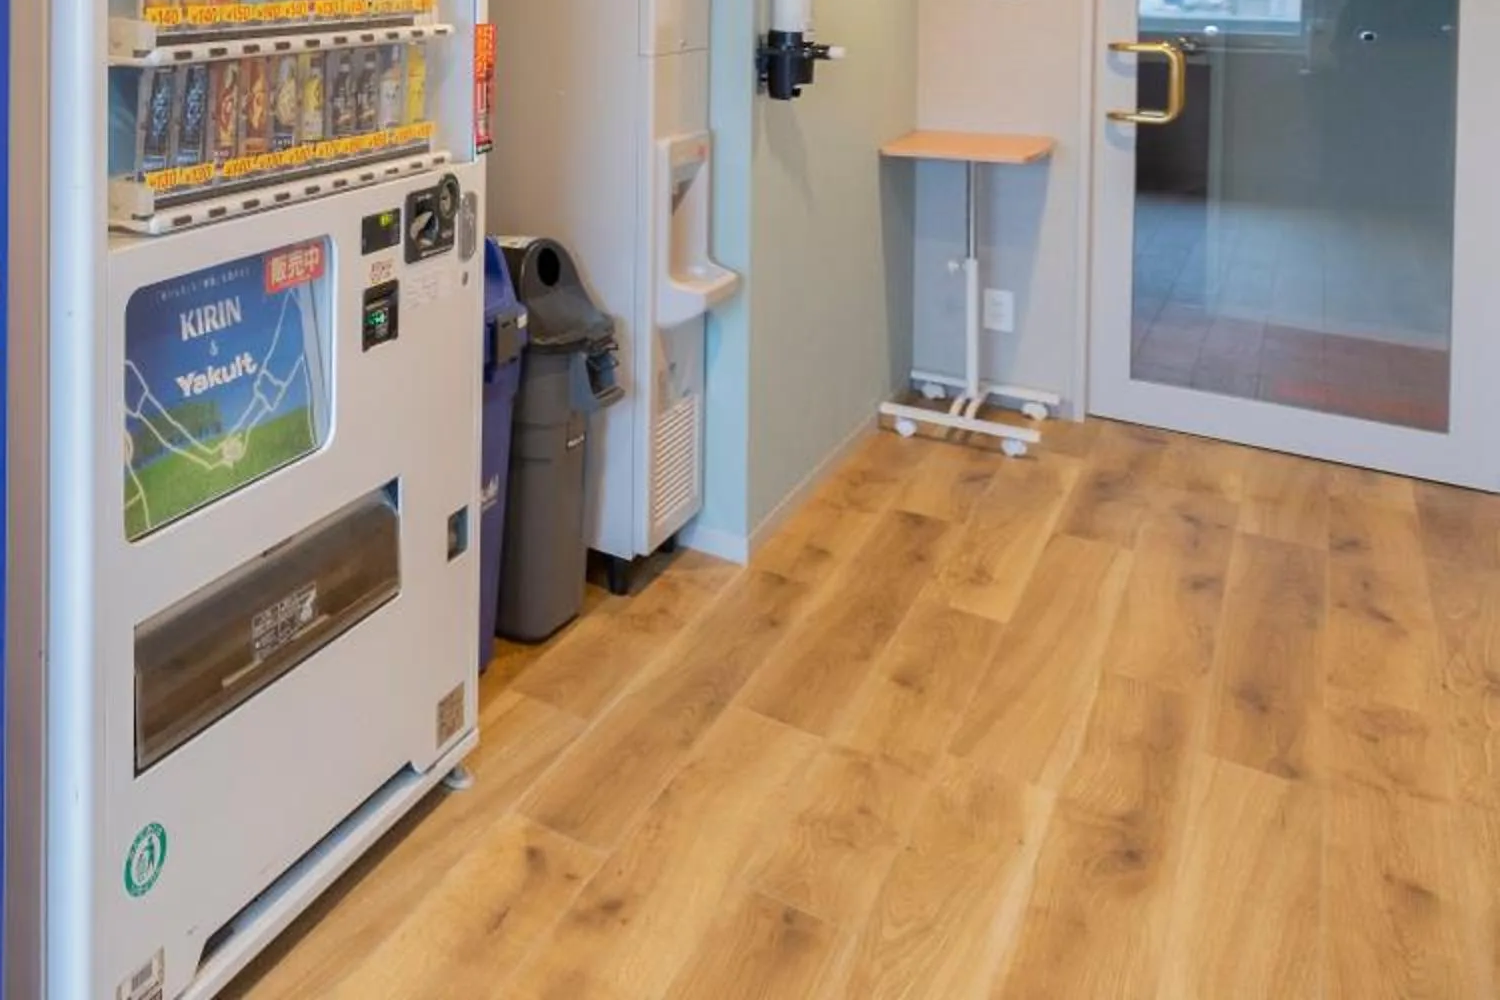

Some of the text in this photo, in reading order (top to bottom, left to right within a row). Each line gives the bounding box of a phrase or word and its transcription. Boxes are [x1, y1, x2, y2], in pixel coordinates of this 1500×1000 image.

[271, 247, 320, 284] 販売中
[179, 296, 242, 342] KIRIN
[176, 352, 258, 397] Yakult
